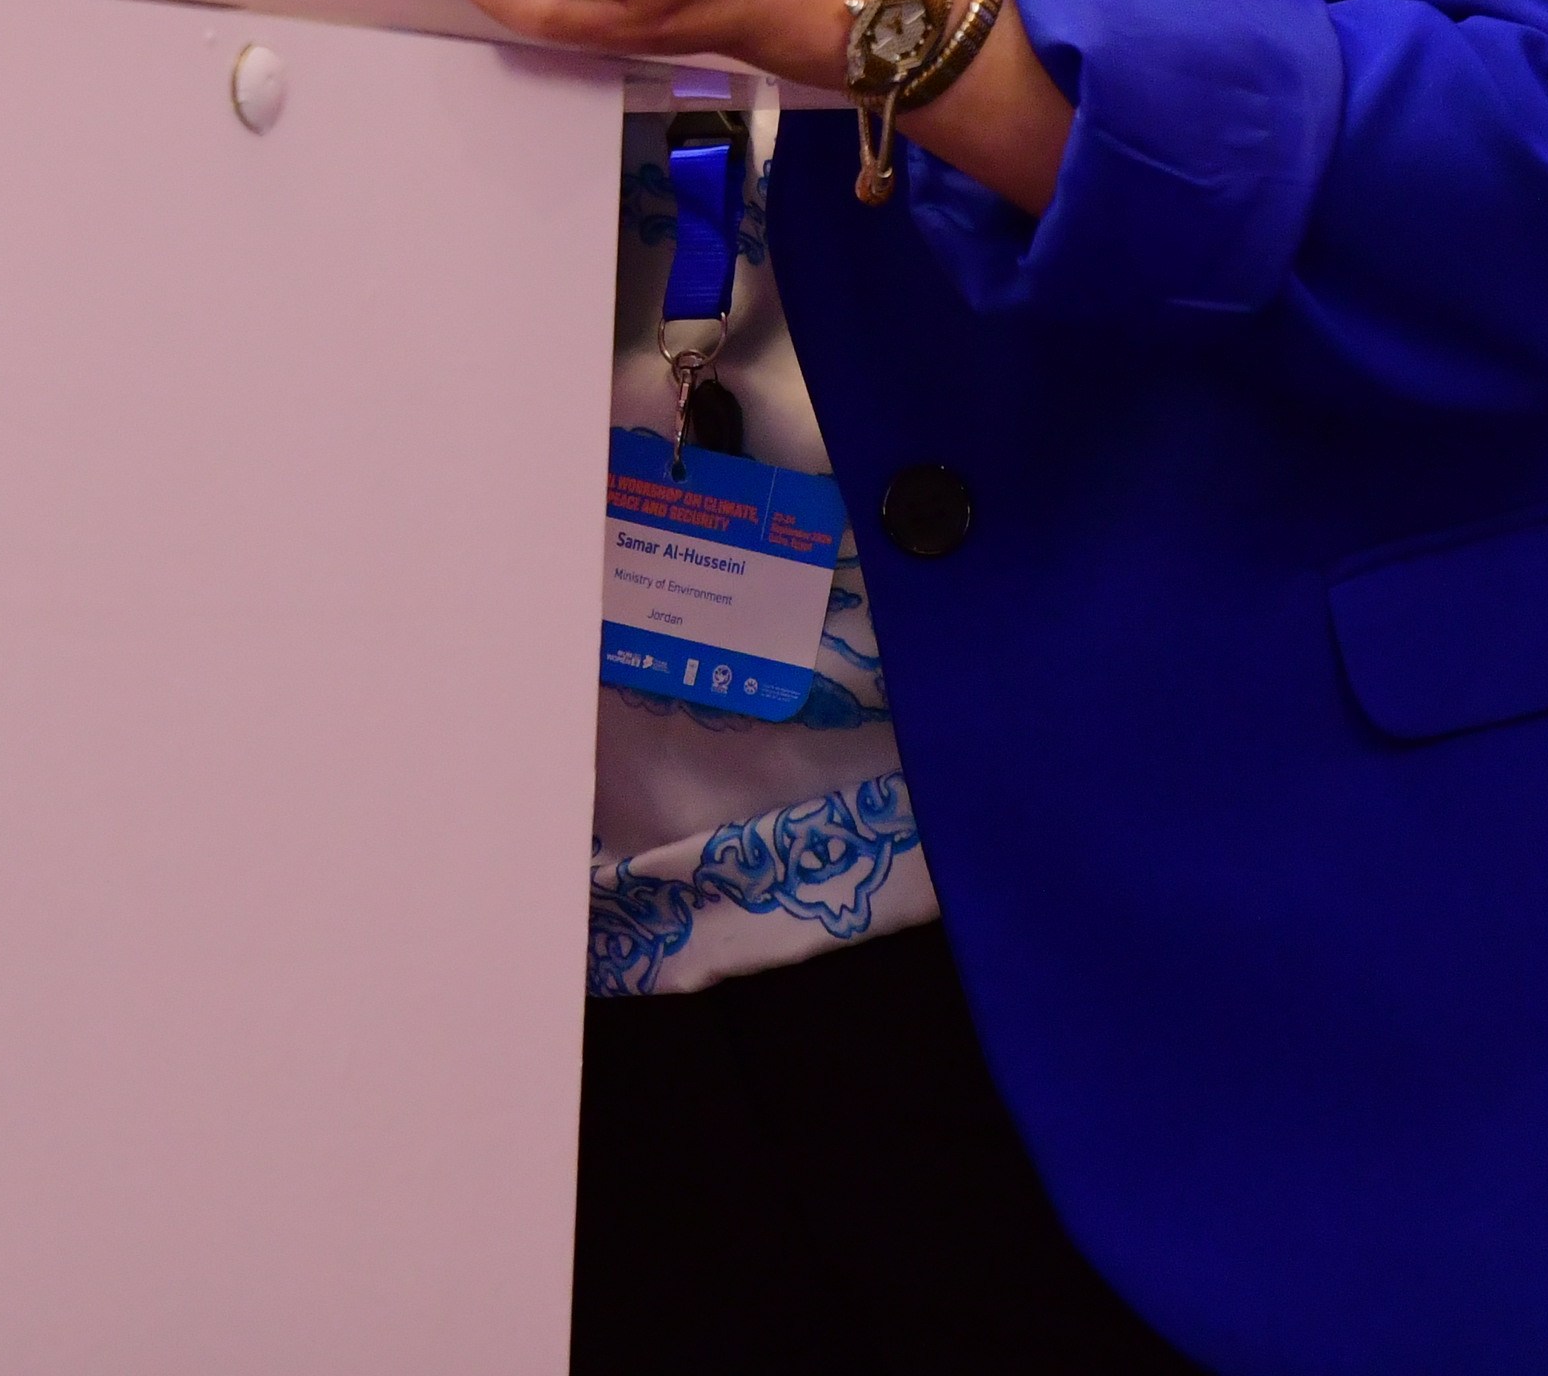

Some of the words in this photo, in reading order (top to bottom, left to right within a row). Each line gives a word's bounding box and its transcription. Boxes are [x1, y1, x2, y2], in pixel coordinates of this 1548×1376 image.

[616, 531, 661, 554] Samar
[662, 543, 746, 576] Al-Husseini
[613, 567, 654, 590] Ministry
[654, 578, 666, 590] of
[667, 580, 733, 607] Environment
[647, 608, 684, 627] Jordan
